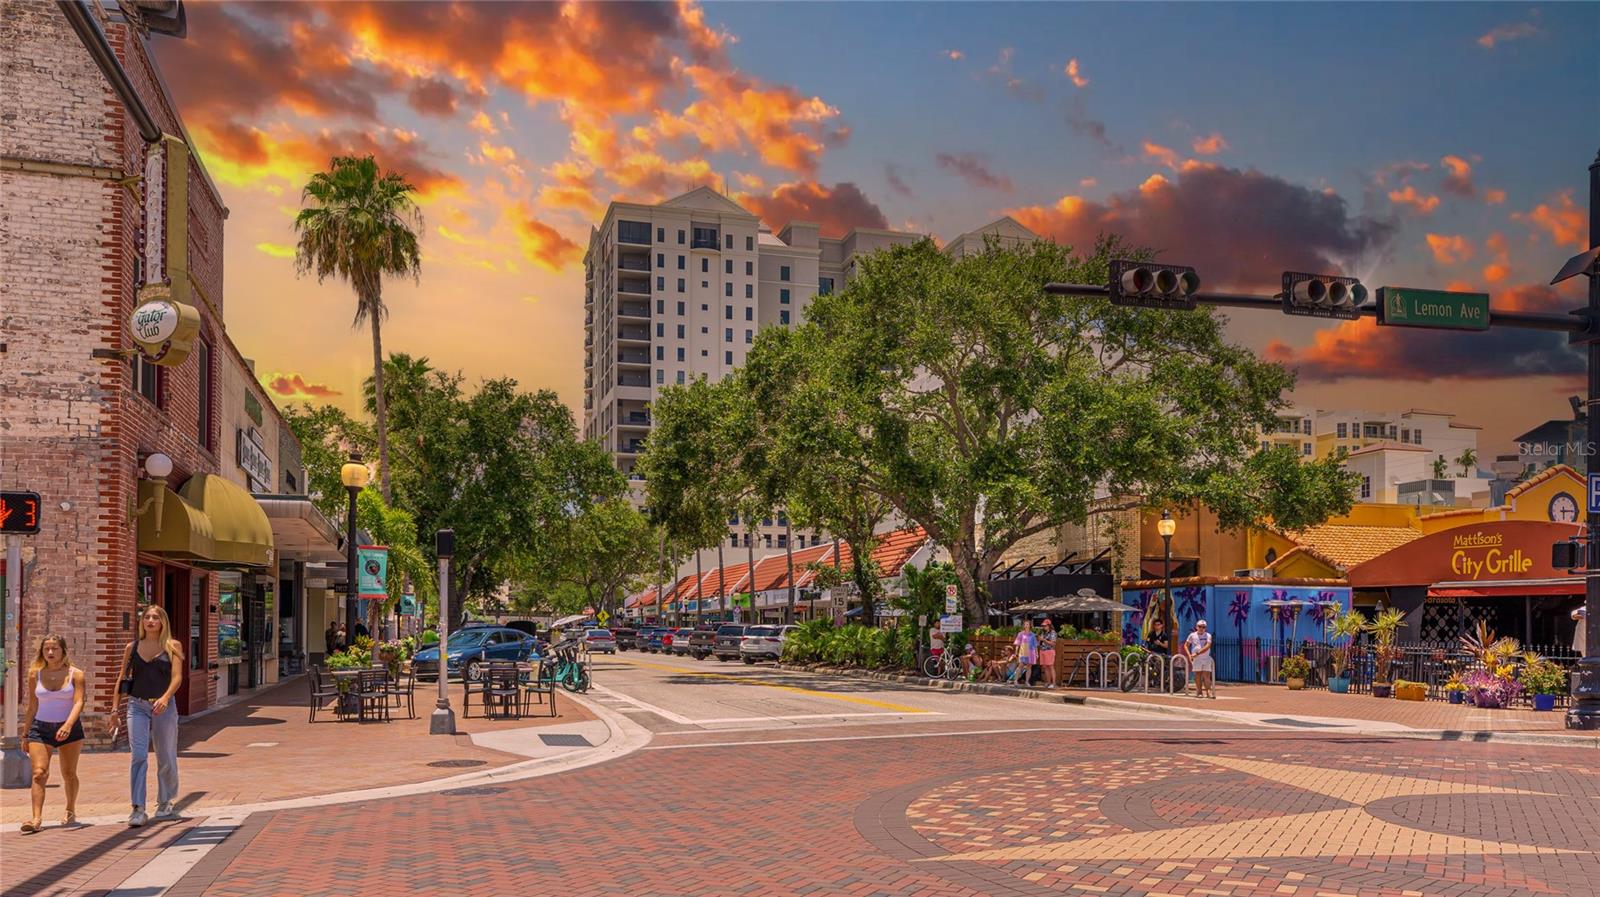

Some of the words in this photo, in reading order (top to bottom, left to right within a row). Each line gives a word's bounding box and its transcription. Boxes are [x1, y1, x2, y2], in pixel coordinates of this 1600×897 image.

[137, 309, 167, 328] Gator
[1415, 300, 1452, 317] Lemon
[1460, 303, 1481, 319] Ave
[137, 322, 160, 339] Club
[25, 499, 37, 527] 3
[1453, 532, 1503, 547] Mattison's
[1452, 550, 1483, 580] City
[1486, 548, 1532, 575] Grille
[834, 597, 845, 606] 15
